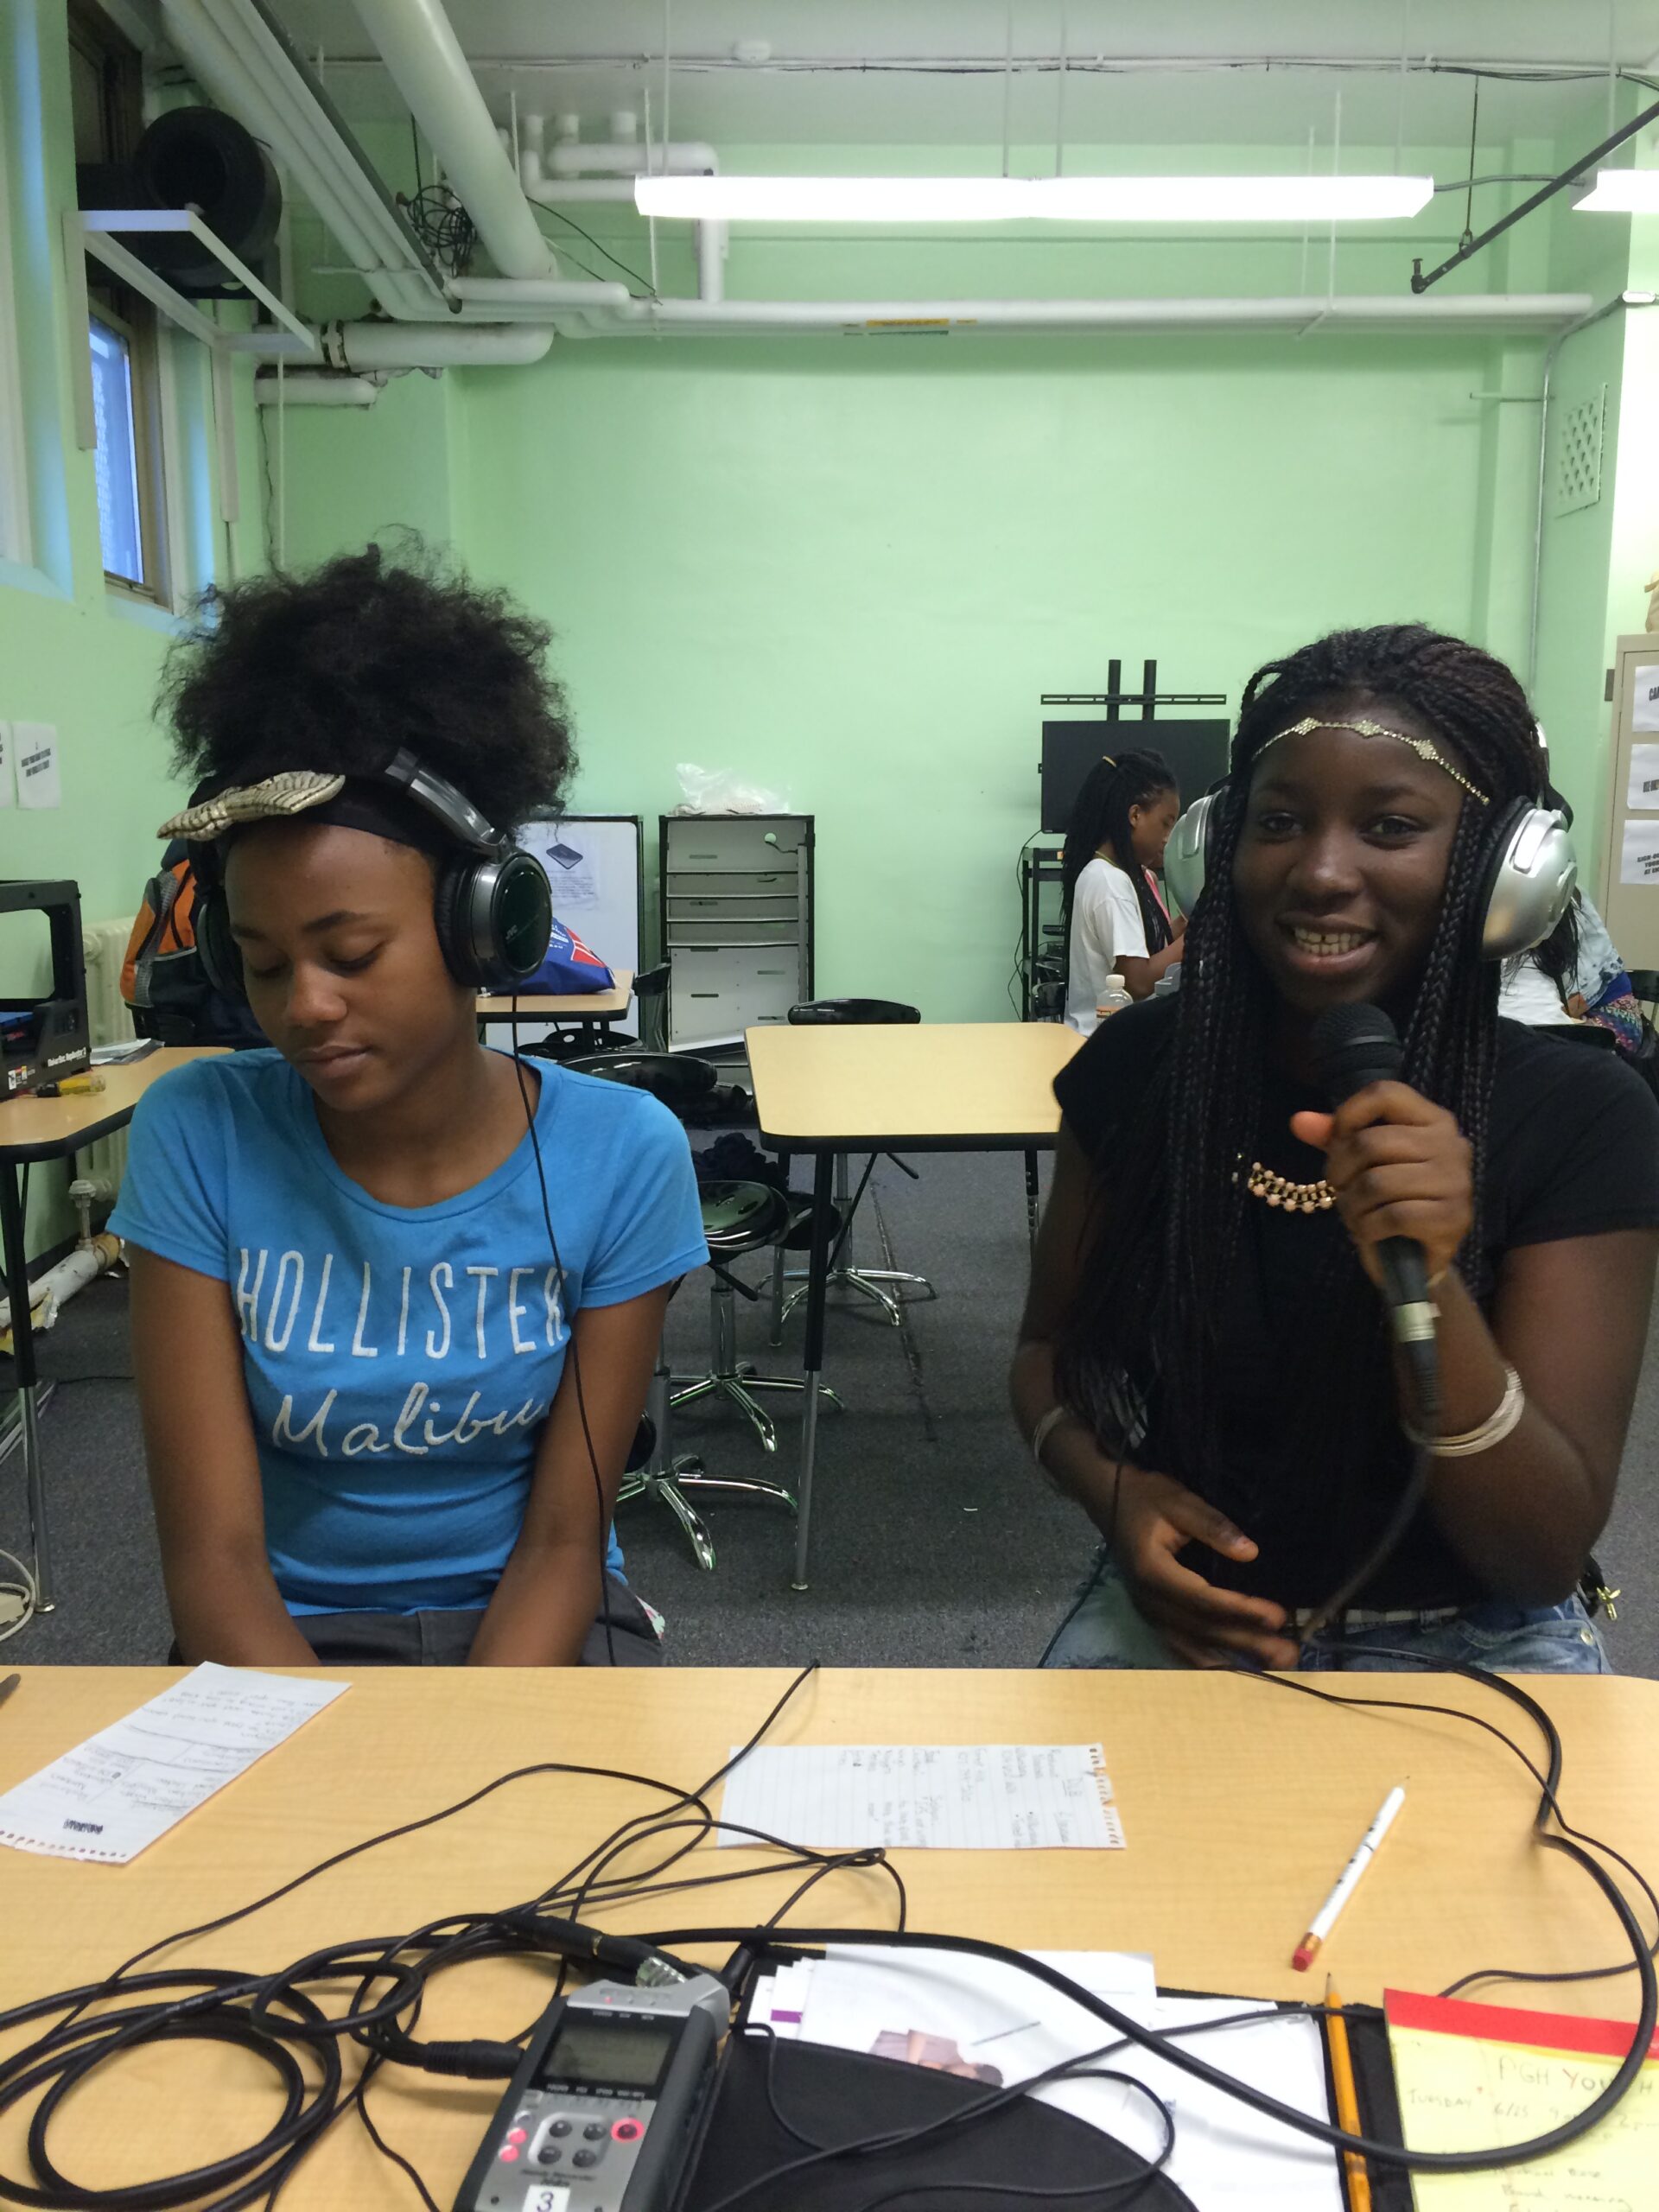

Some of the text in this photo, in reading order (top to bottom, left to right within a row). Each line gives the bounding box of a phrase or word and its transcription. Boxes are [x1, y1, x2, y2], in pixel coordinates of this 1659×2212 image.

[505, 924, 518, 940] JVC
[237, 1248, 569, 1359] HOLLISTER
[273, 1382, 544, 1457] Malibu
[537, 2190, 554, 2212] 3
